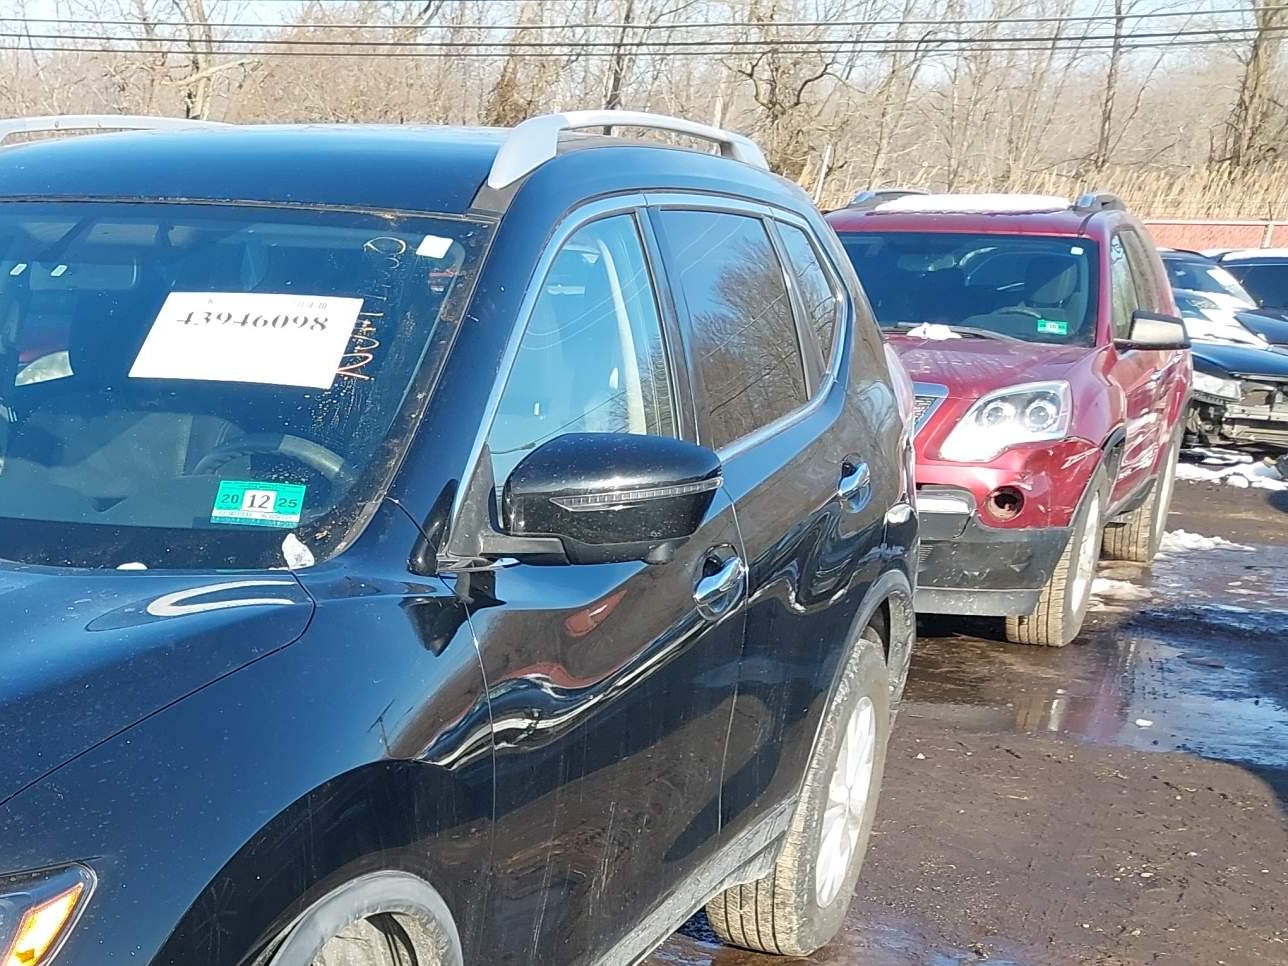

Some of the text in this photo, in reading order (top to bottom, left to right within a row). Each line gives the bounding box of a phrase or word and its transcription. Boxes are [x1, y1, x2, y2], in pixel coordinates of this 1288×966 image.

[176, 311, 329, 331] 43946098
[221, 493, 298, 509] 20 12 25
